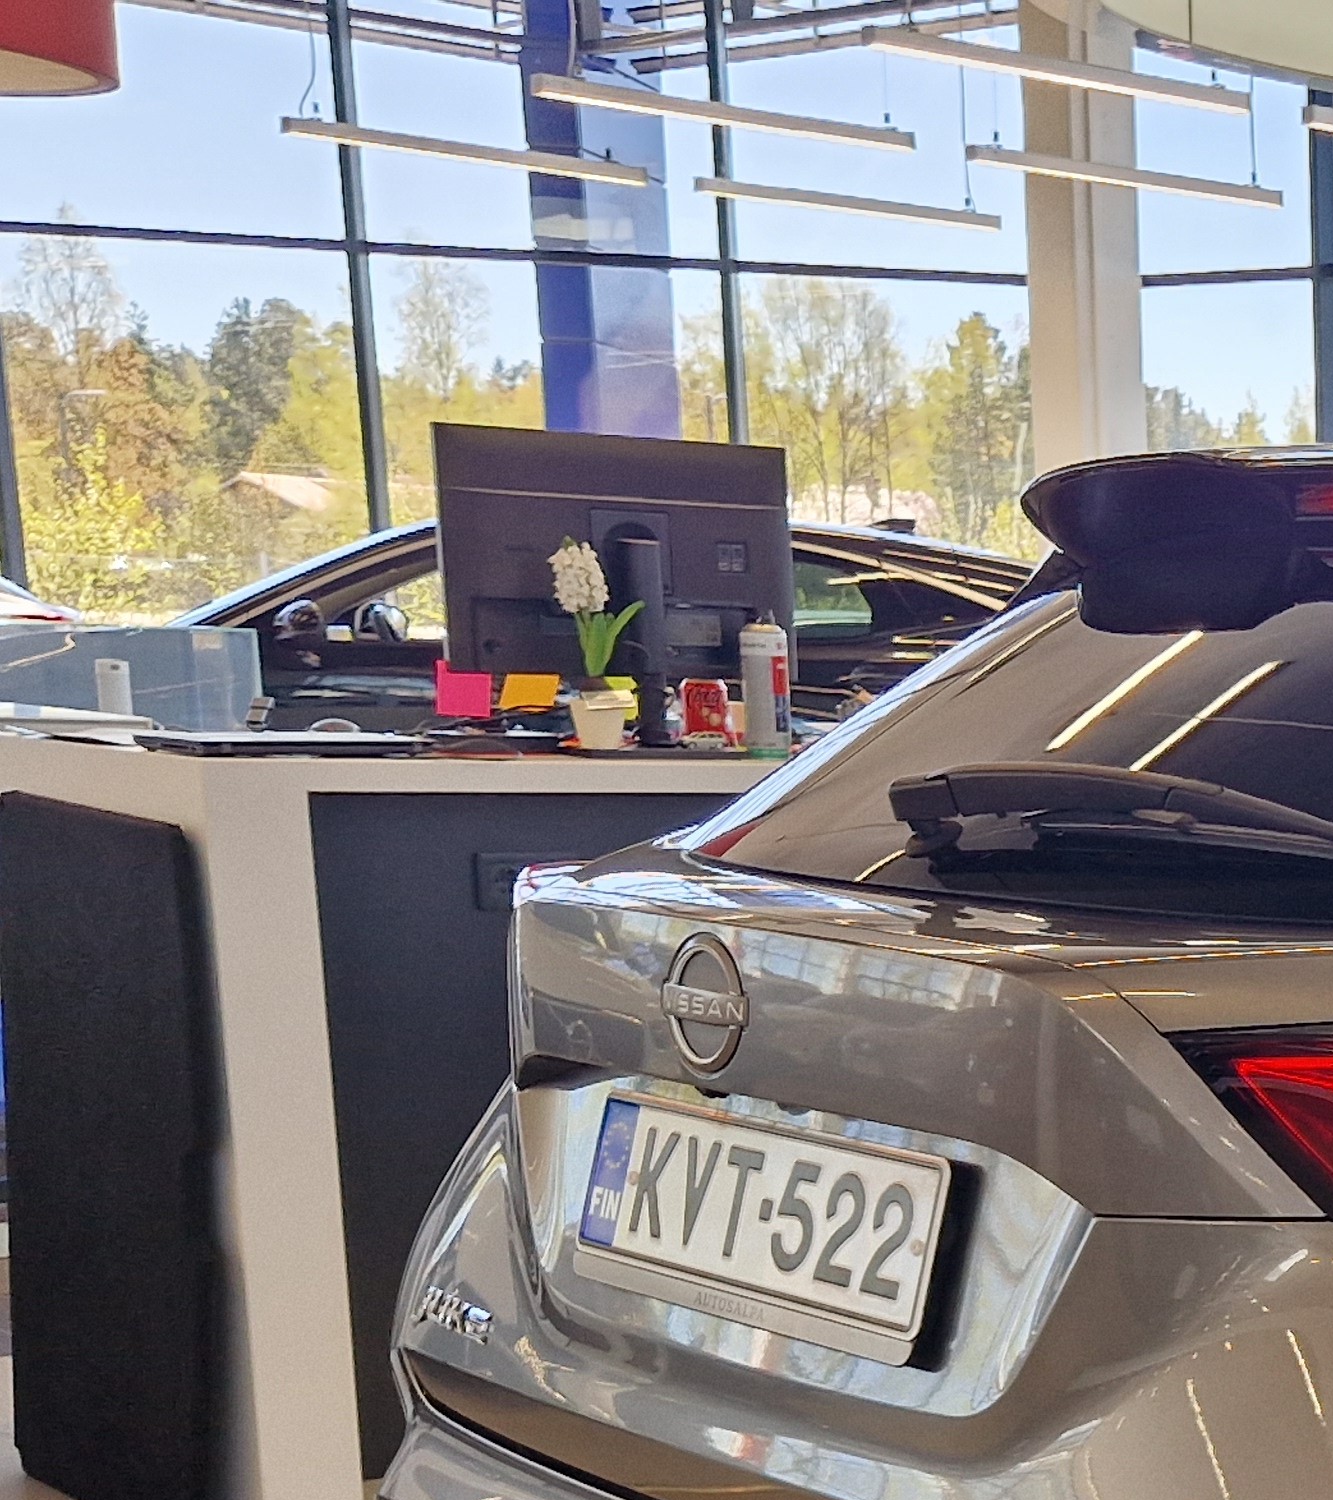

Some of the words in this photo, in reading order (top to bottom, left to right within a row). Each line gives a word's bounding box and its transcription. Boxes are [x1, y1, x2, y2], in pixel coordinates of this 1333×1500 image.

[588, 1185, 621, 1220] FIN
[629, 1126, 915, 1301] KVT-522
[693, 1291, 765, 1323] AUTOSALPA
